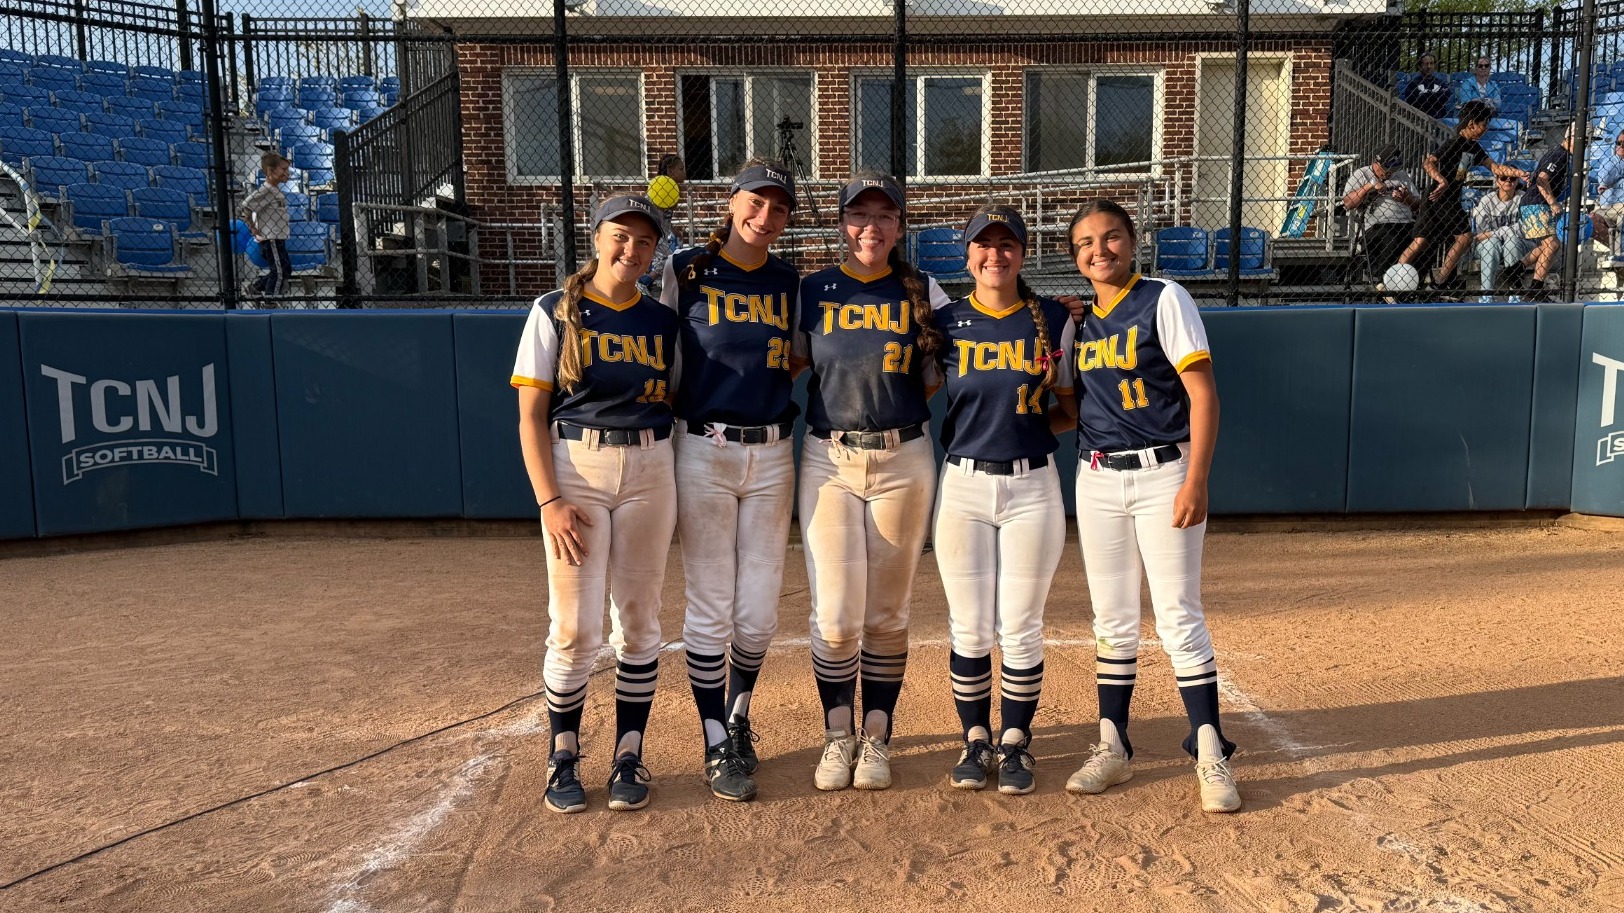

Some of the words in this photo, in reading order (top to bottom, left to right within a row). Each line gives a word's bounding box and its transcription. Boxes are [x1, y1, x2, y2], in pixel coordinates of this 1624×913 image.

[765, 168, 787, 184] TCNJ
[861, 179, 884, 188] TCNJ
[628, 198, 651, 213] TCNJ
[987, 213, 1009, 223] TCNJ
[700, 285, 789, 331] TCNJ
[818, 300, 910, 336] TCNJ
[577, 327, 666, 371] TCNJ
[882, 341, 913, 374] 21
[953, 338, 1044, 378] TCNJ
[40, 362, 218, 445] TCNJ
[636, 378, 667, 404] 15
[1118, 377, 1149, 411] 11
[79, 445, 203, 468] SOFTBALL
